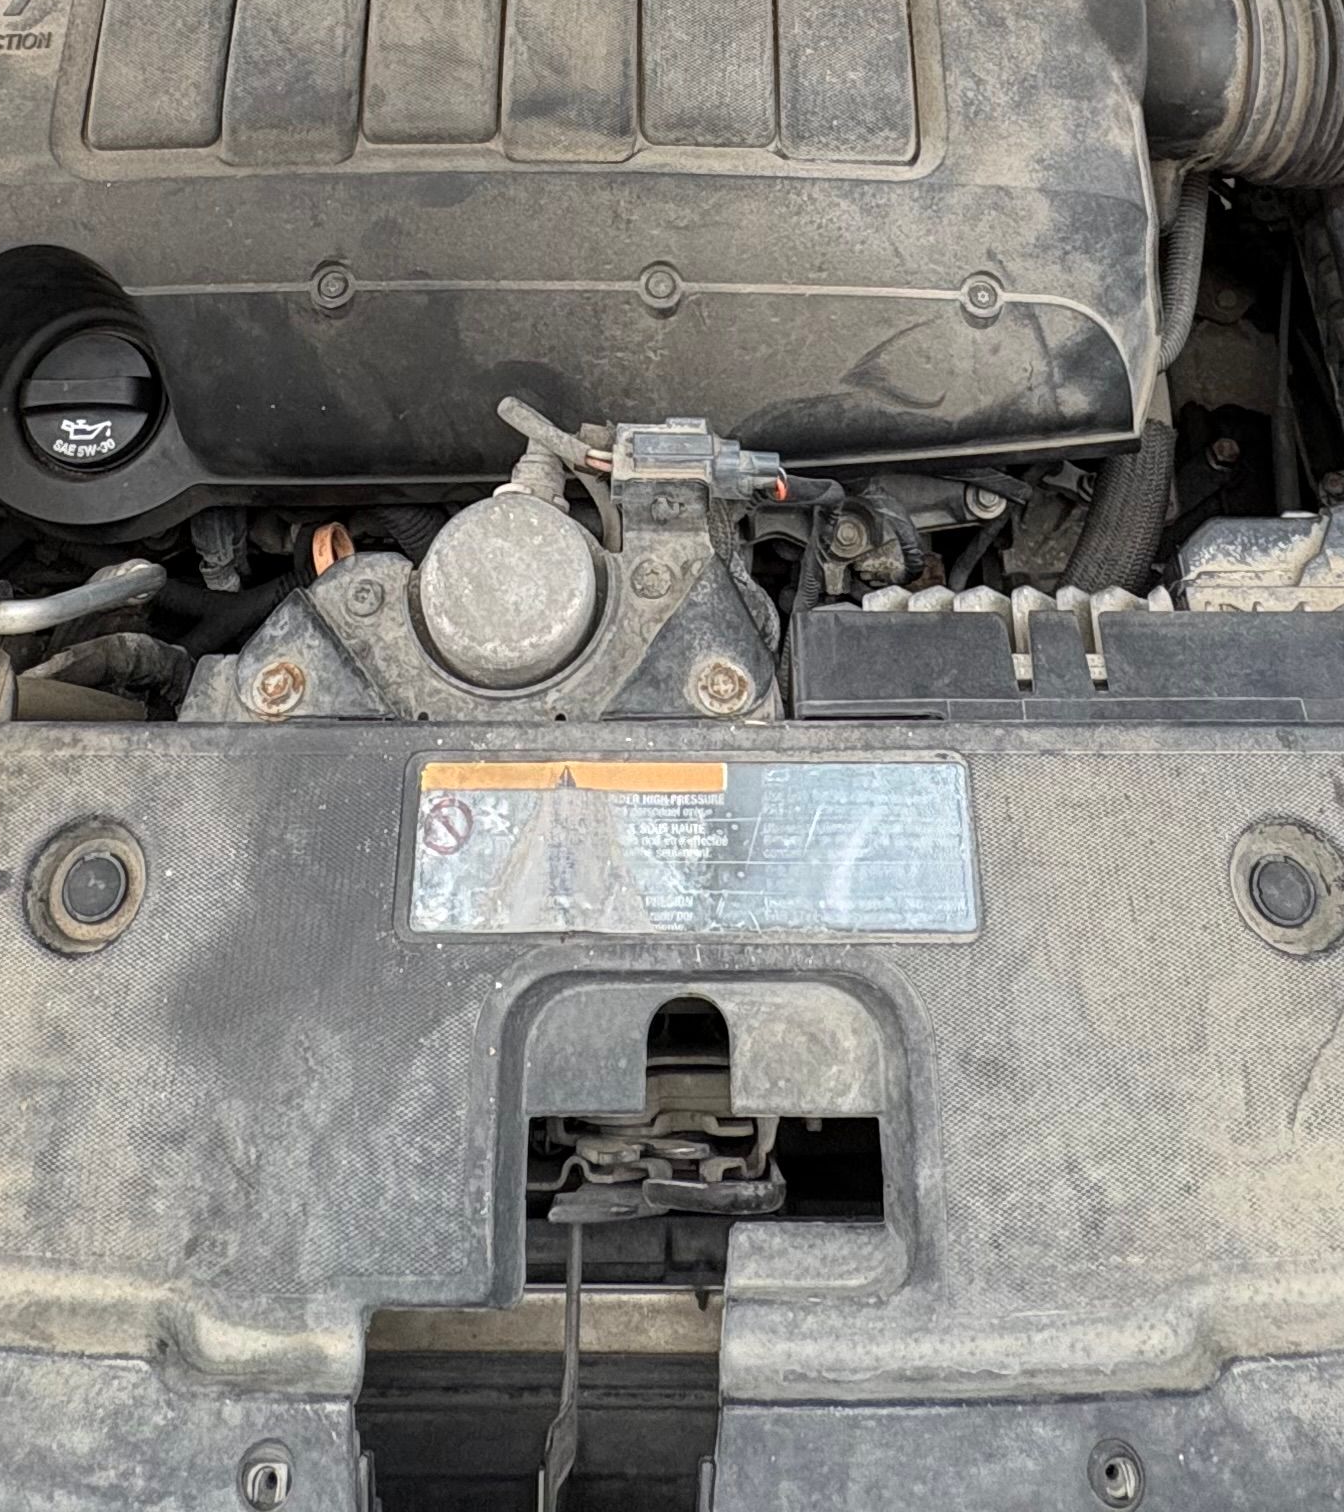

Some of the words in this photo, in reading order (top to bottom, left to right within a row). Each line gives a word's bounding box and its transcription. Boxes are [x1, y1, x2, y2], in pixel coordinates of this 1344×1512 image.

[52, 438, 77, 457] SAE
[76, 438, 116, 458] 5W-30
[670, 793, 725, 806] PRESSURE
